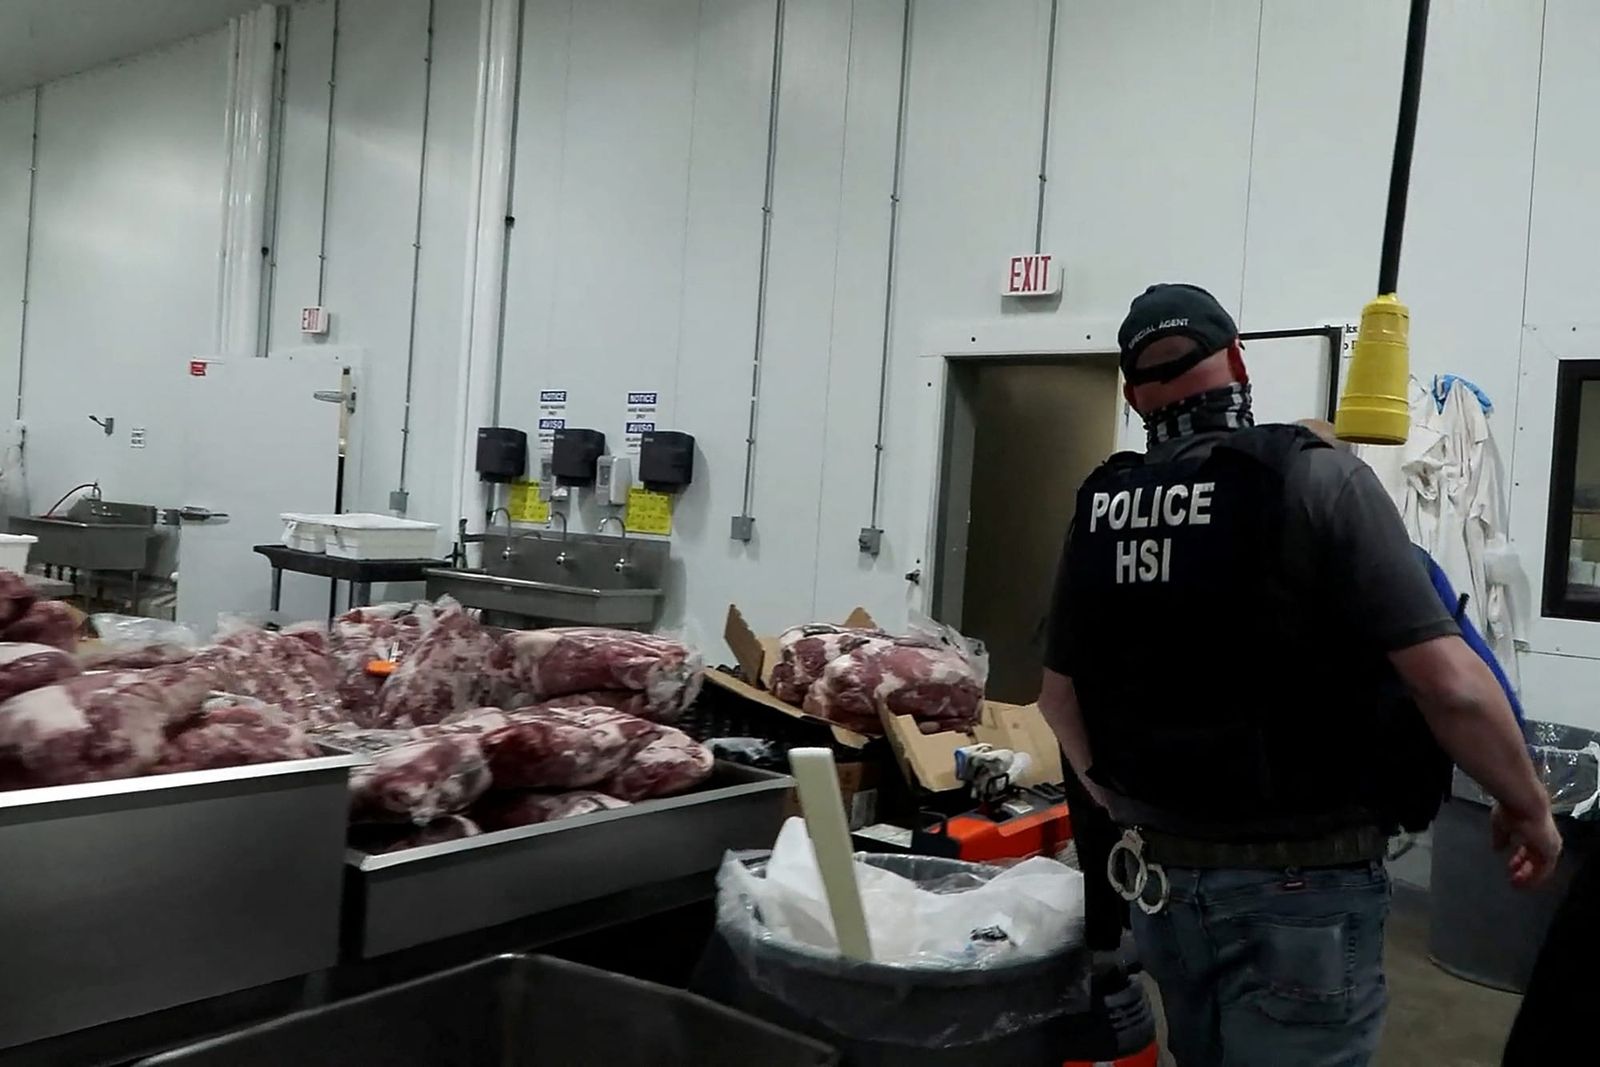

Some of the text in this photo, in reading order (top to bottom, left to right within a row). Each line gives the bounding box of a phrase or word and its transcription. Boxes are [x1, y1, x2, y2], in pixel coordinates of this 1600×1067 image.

[1010, 256, 1051, 292] EXIT
[1128, 318, 1189, 350] SPECIAL AGENT
[630, 394, 656, 403] NOTICE
[1090, 481, 1216, 533] POLICE
[1116, 538, 1172, 583] HSI
